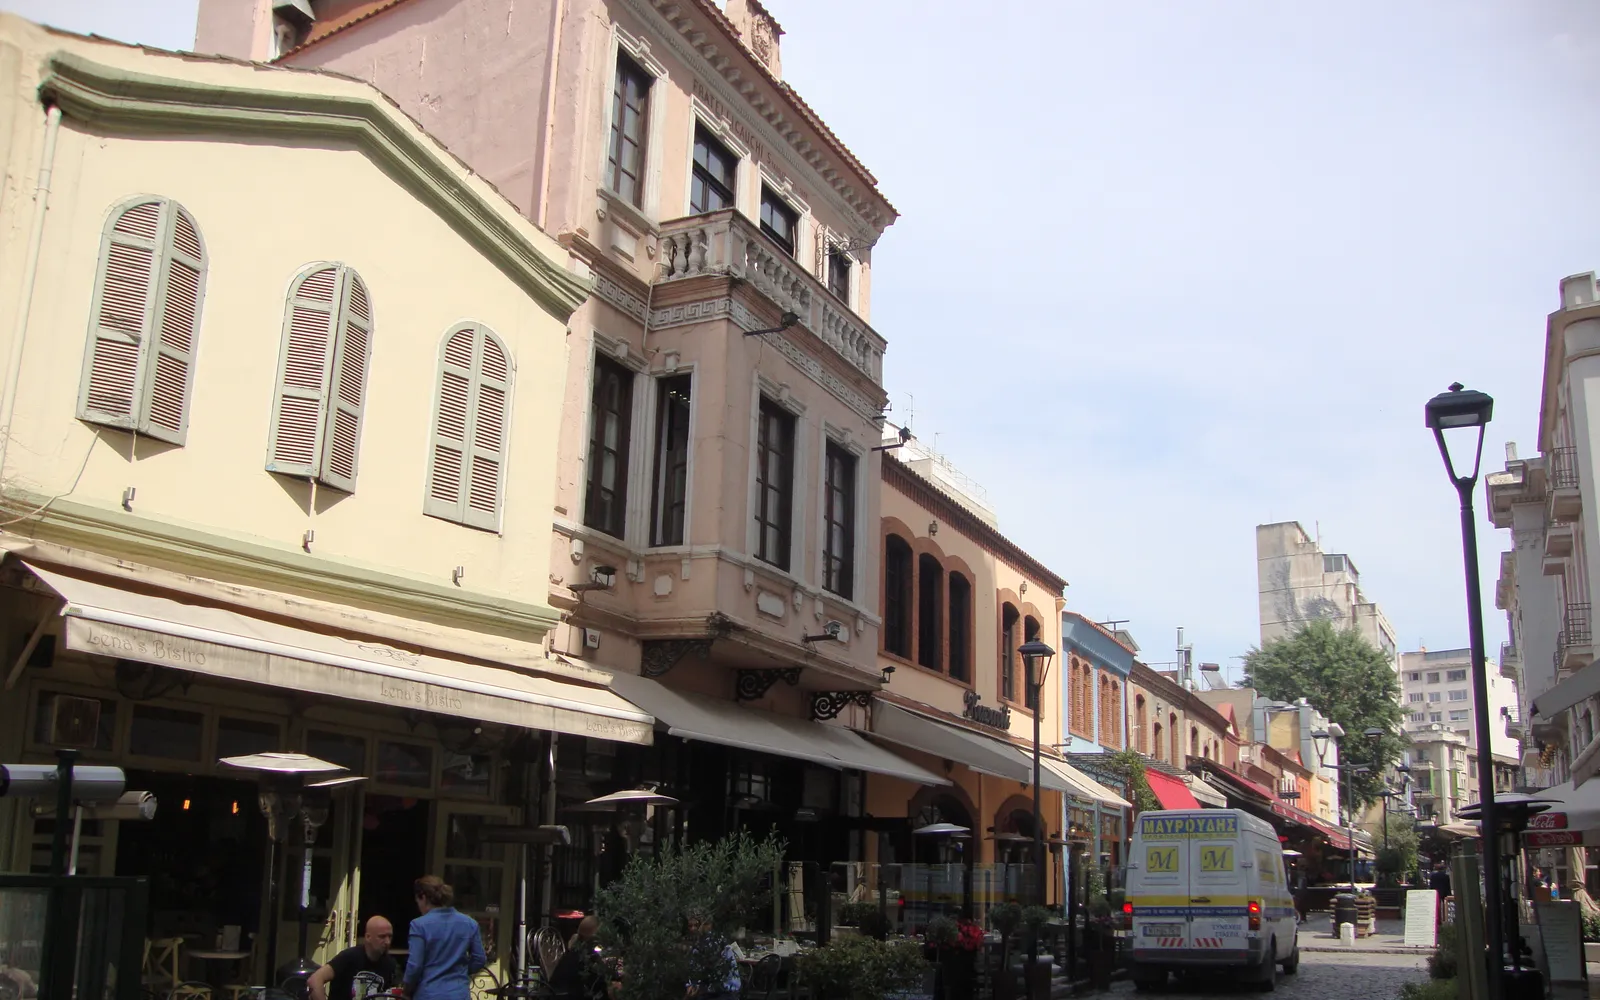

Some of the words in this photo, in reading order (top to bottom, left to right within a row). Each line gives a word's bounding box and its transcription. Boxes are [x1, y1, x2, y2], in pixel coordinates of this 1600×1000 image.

[86, 627, 148, 654] Lena's
[153, 639, 206, 666] Bistro
[380, 681, 421, 703] Lena's
[424, 687, 462, 710] Bistro
[586, 718, 616, 735] Lena's
[1143, 819, 1236, 833] ΜΑΥΡΟΥΔΗΣ
